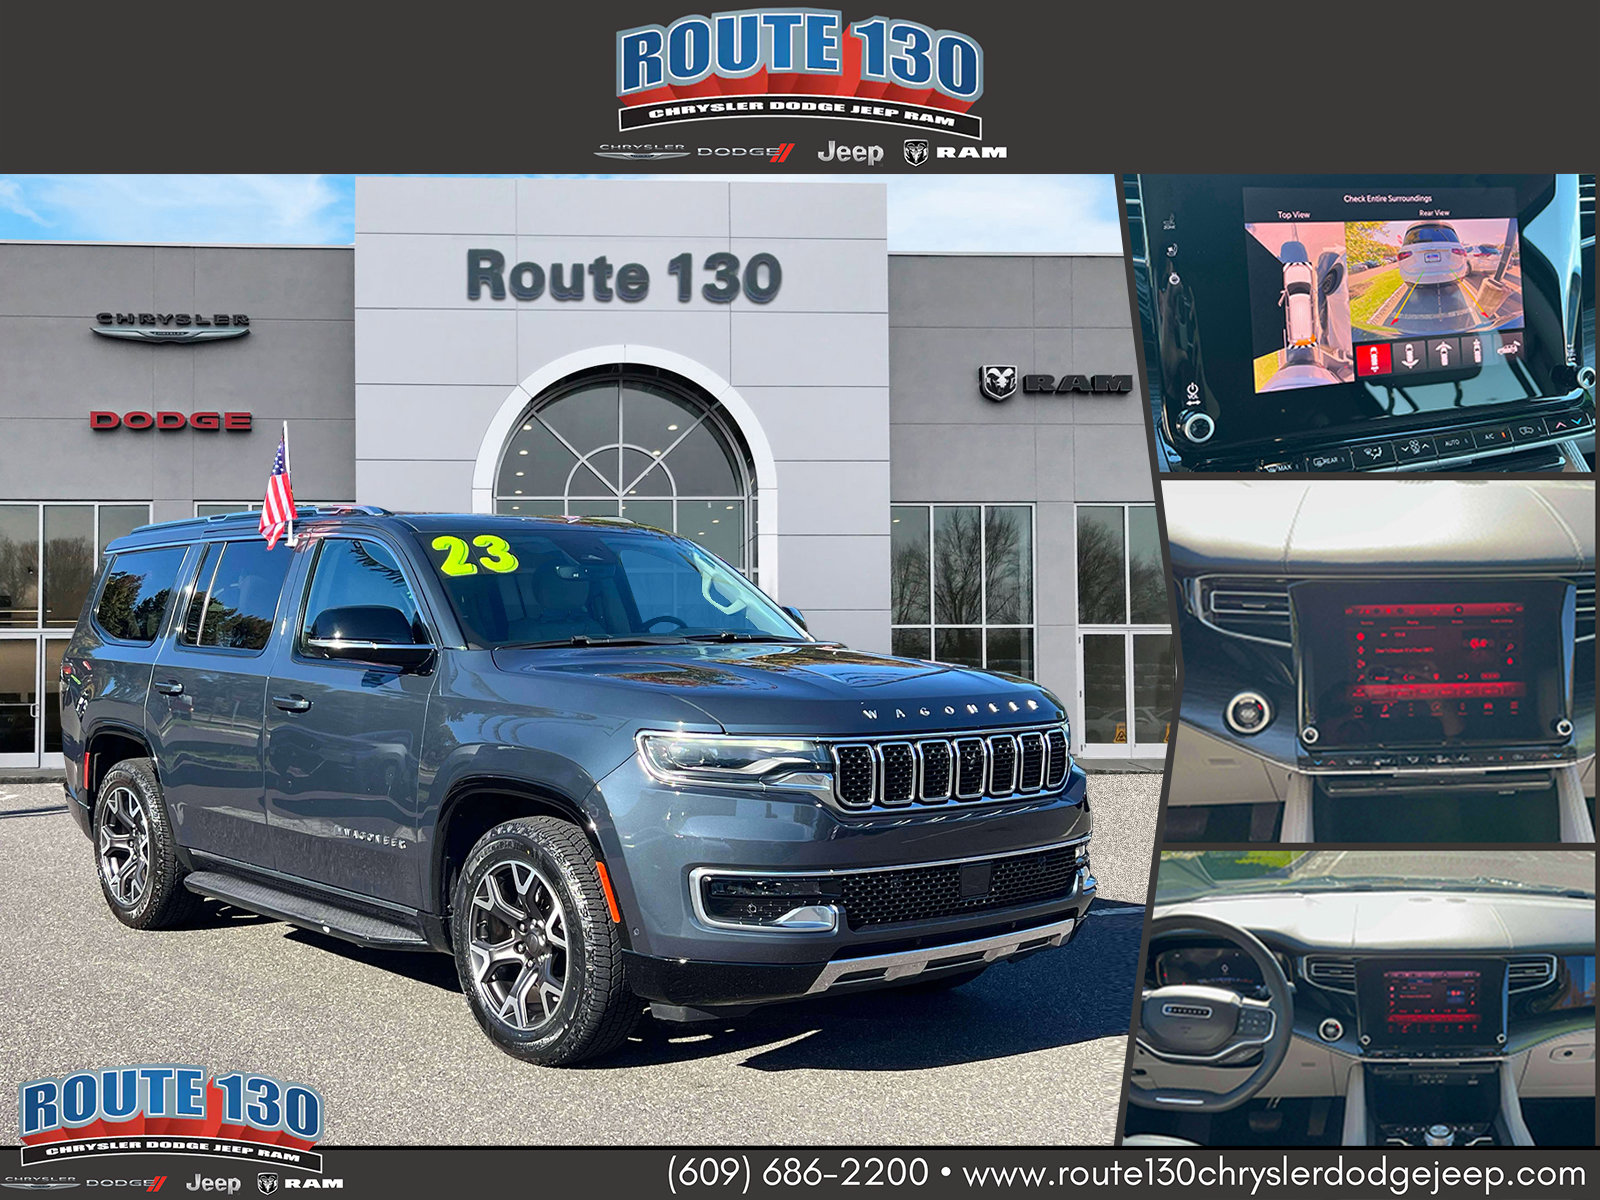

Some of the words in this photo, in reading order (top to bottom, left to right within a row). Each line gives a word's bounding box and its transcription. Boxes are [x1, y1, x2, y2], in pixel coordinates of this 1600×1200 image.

[1344, 194, 1366, 204] Check
[1367, 194, 1387, 203] Entire
[1388, 194, 1432, 204] Surroundings
[1278, 210, 1293, 220] Top
[1293, 210, 1311, 219] View
[1419, 208, 1433, 216] Rear
[1434, 207, 1451, 216] View
[467, 248, 650, 302] Route
[668, 251, 783, 304] 130
[96, 312, 250, 327] CHRYSLER
[1023, 374, 1134, 394] RAM
[89, 410, 253, 432] DODGE
[431, 534, 520, 577] 23
[862, 699, 1039, 720] WAGONEER
